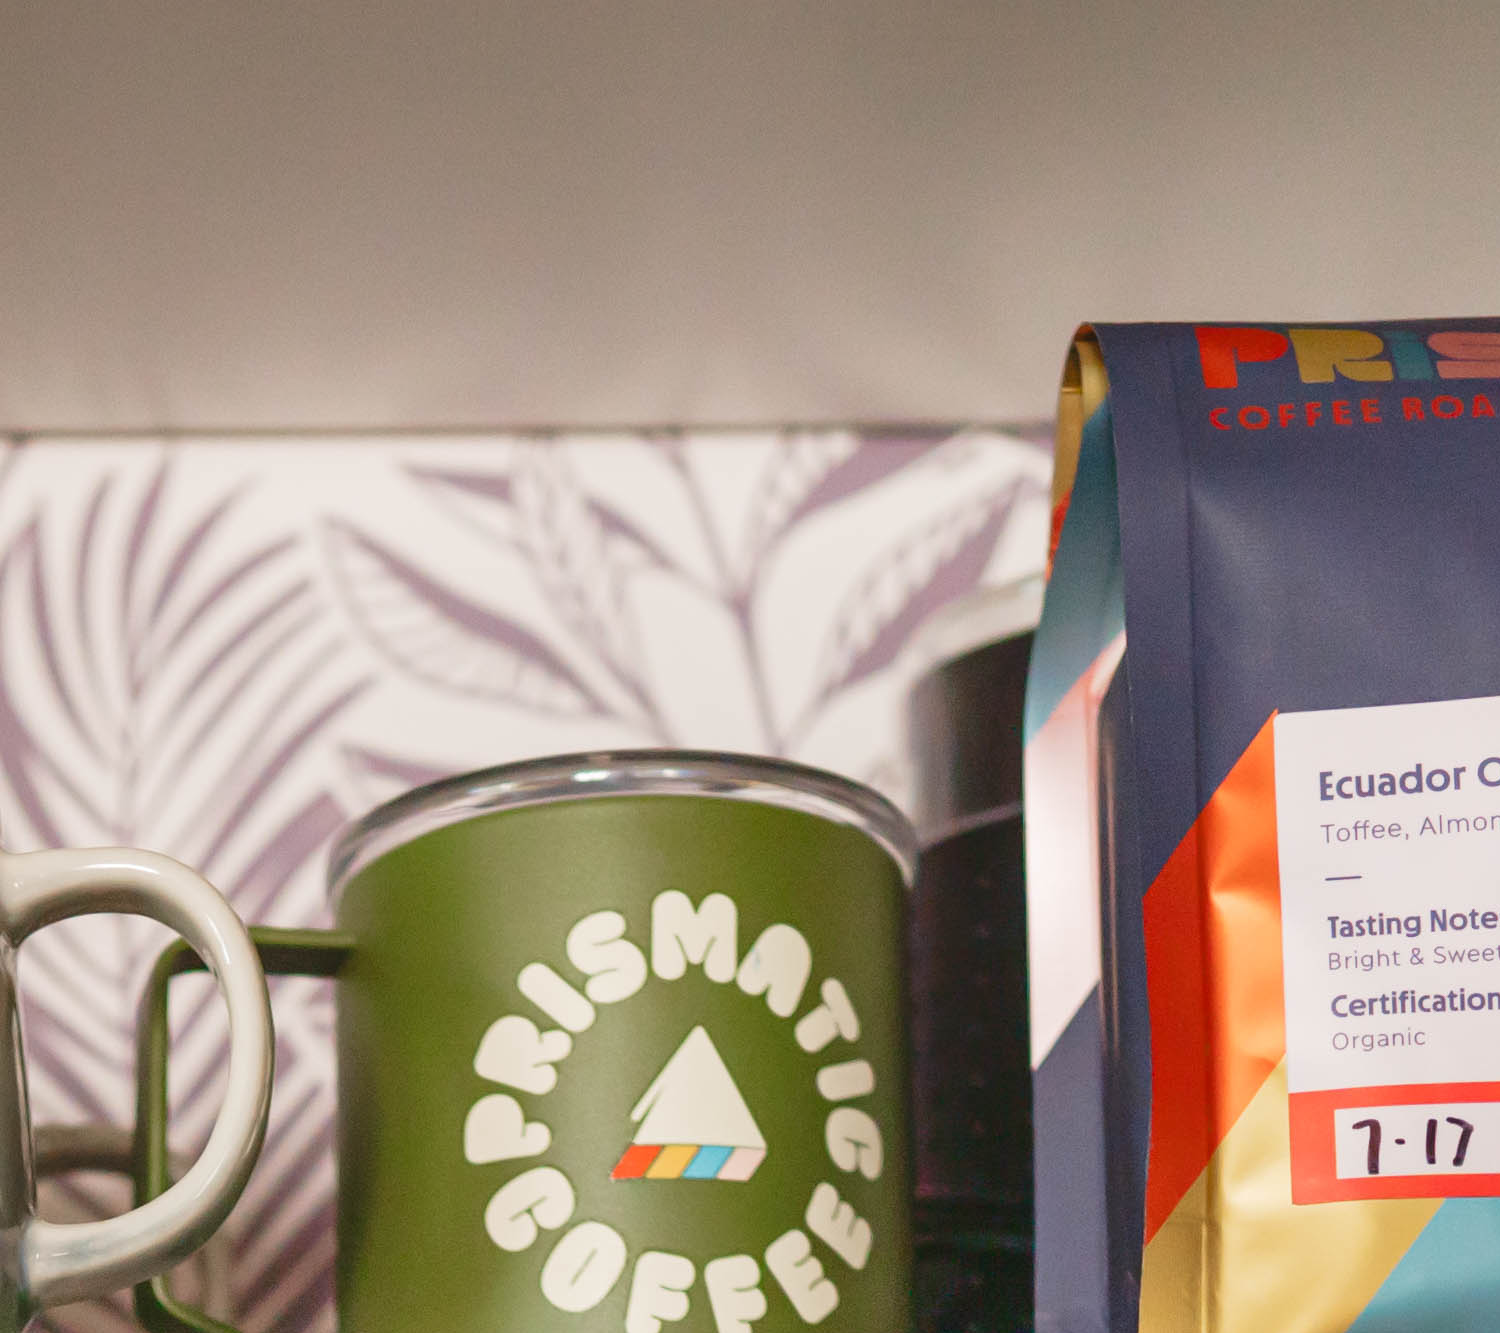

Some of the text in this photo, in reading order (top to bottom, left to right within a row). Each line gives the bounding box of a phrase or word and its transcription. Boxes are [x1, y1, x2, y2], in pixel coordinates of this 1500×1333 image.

[1208, 402, 1383, 431] COFFEE
[1319, 763, 1466, 801] Ecuador
[1320, 820, 1411, 845] Toffee,
[1327, 910, 1422, 941] Tasting
[1328, 947, 1401, 973] Bright
[1410, 947, 1424, 966] &
[463, 890, 884, 1181] PRISMATIC
[1332, 1027, 1427, 1053] Organic
